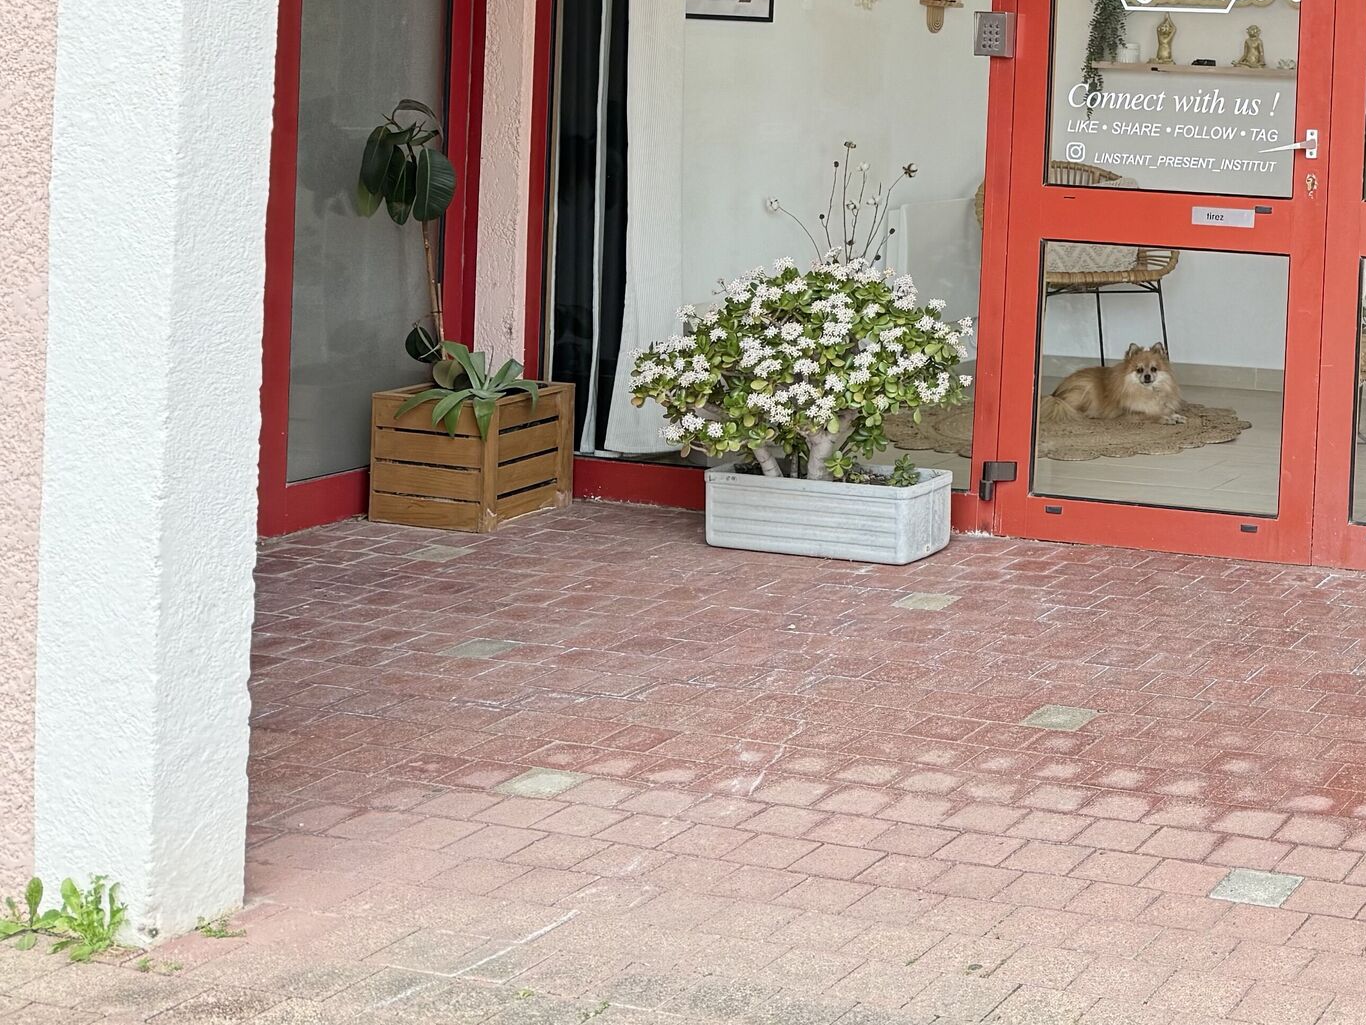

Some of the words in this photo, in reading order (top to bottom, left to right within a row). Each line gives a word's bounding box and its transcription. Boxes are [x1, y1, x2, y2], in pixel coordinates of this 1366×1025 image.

[1068, 83, 1166, 112] Connect
[1173, 89, 1225, 114] with
[1234, 98, 1262, 116] us
[1067, 119, 1099, 134] LIKE
[1111, 121, 1162, 137] SHARE
[1173, 124, 1238, 140] FOLLOW
[1250, 128, 1279, 142] TAG
[1094, 152, 1277, 173] LINSTANT_PRESENT_INSTITUT
[1206, 211, 1224, 222] tirez
